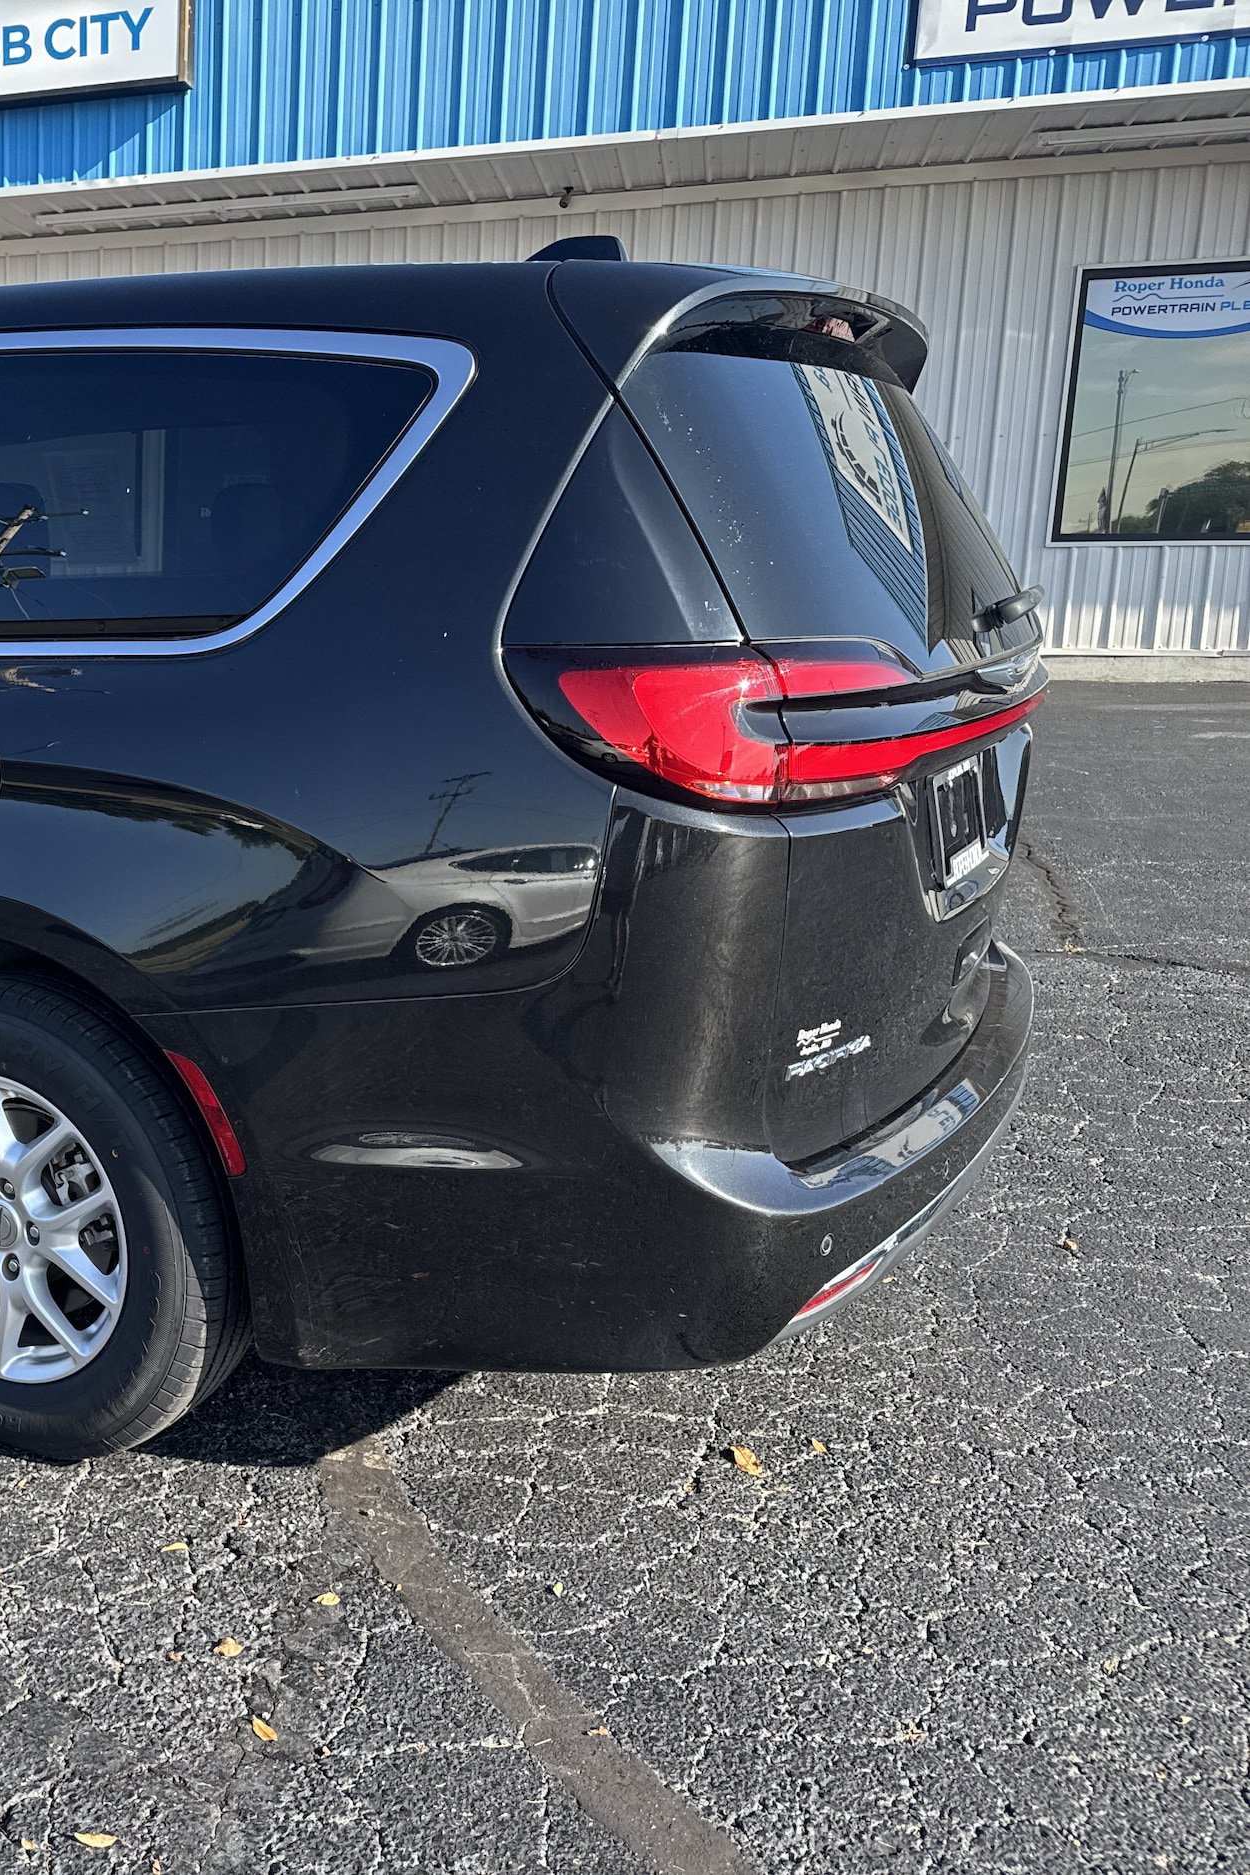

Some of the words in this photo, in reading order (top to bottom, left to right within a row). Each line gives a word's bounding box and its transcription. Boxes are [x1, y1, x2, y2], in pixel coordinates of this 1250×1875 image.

[43, 7, 153, 60] CITY
[1113, 280, 1165, 294] Roper
[1169, 276, 1225, 290] Honda
[1111, 302, 1216, 316] POWERTRAIN
